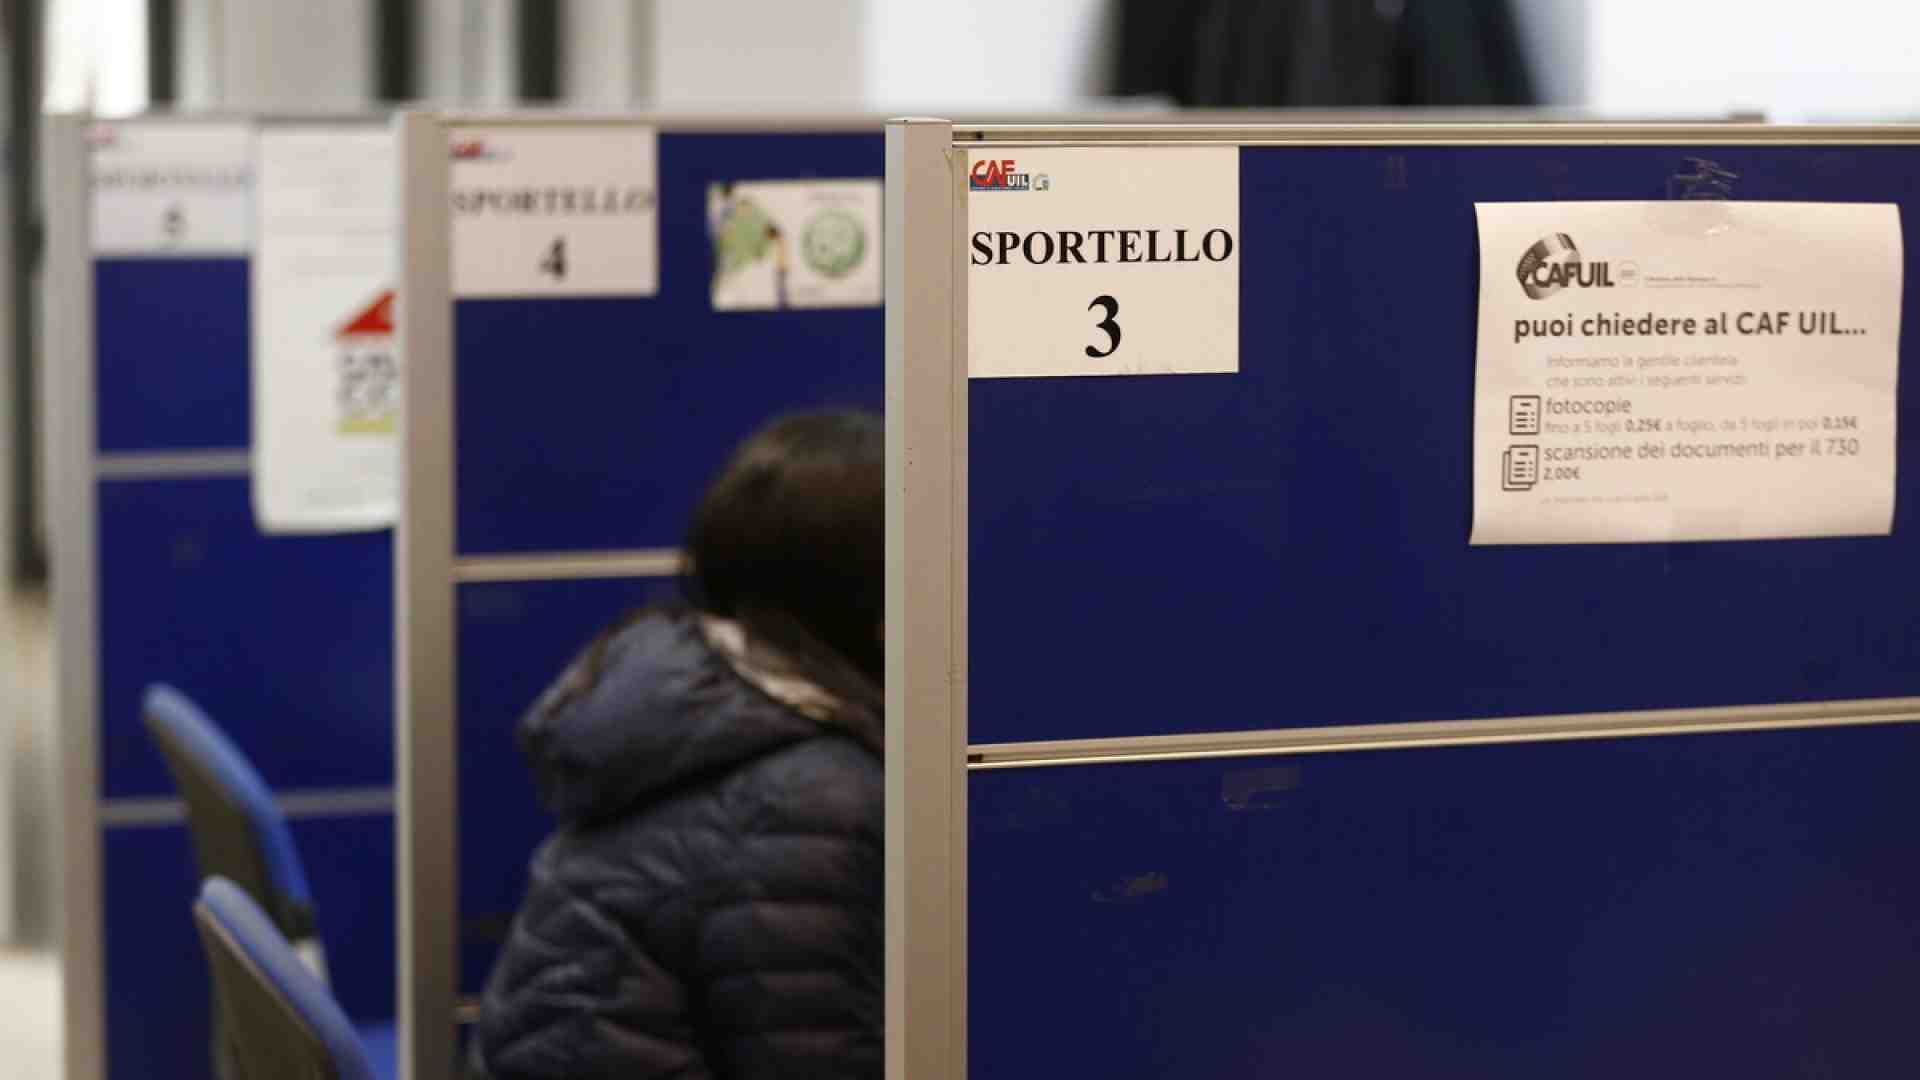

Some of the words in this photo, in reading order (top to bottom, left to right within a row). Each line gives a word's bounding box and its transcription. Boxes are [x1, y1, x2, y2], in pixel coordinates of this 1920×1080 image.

[972, 160, 1015, 188] CAF
[539, 237, 568, 281] 4
[971, 229, 1233, 265] SPORTELLO
[1085, 295, 1121, 358] 3
[1514, 314, 1572, 343] puoi
[1581, 313, 1696, 337] chiedere
[1704, 312, 1728, 335] al
[1737, 312, 1790, 334] CAF
[1798, 311, 1867, 335] UIL...
[1546, 397, 1632, 416] fotocopie
[1544, 444, 1632, 461] scansione
[1637, 442, 1665, 459] dei
[1671, 441, 1770, 459] documenti
[1775, 442, 1804, 461] per
[1824, 437, 1860, 456] 730
